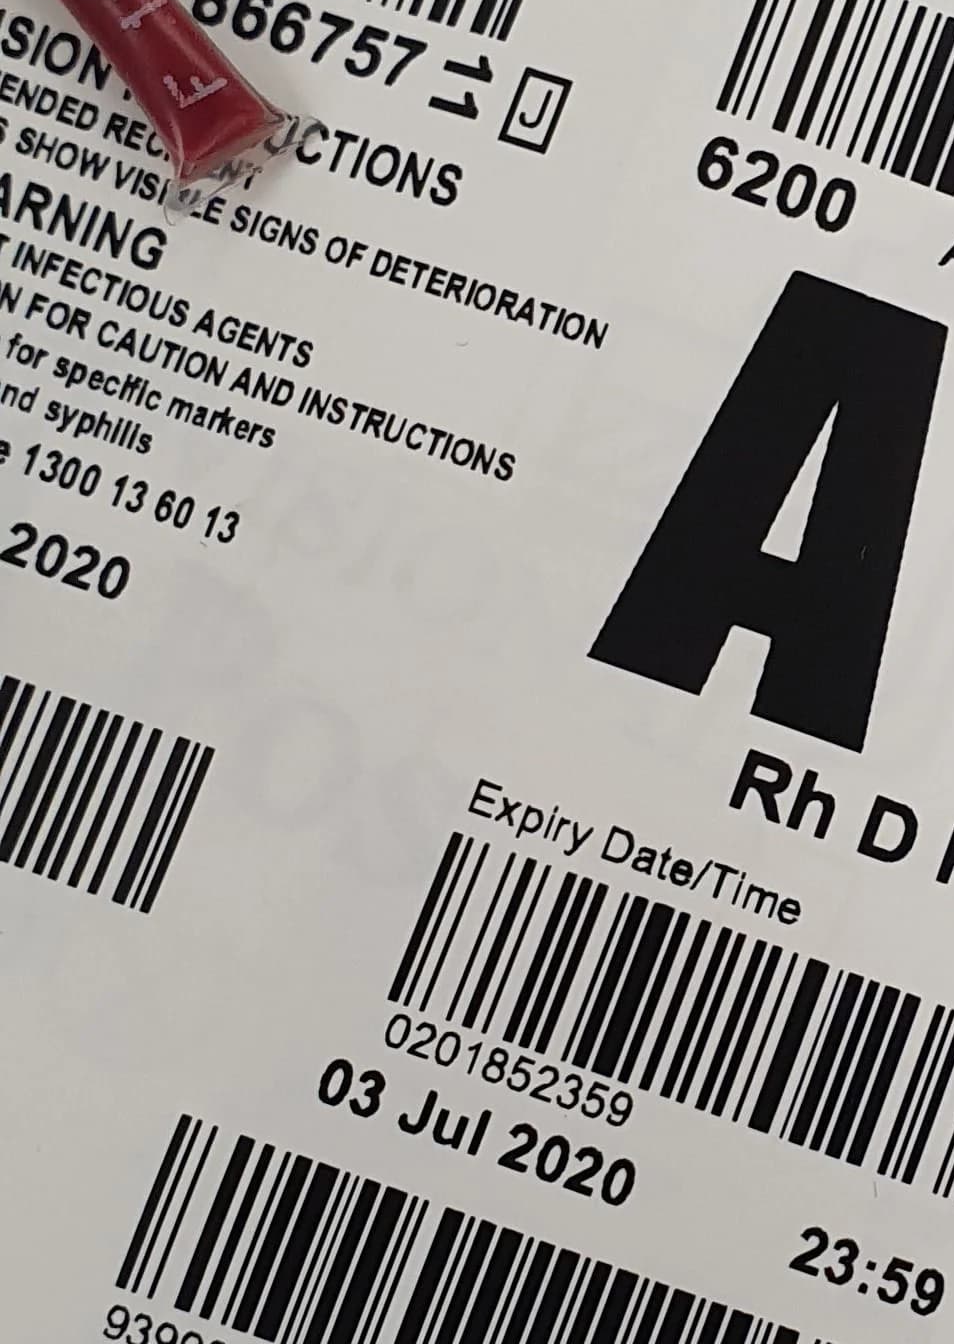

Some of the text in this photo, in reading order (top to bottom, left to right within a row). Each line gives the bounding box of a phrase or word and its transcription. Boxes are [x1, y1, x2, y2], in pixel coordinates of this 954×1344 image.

[0, 9, 112, 91] SION
[163, 75, 228, 108] F
[16, 127, 111, 181] SHOW
[230, 205, 319, 256] SIGNS
[326, 236, 368, 267] OF
[369, 251, 609, 350] DETERIORATION
[697, 136, 857, 233] 6200
[11, 241, 313, 368] INFECTIOUS AGENTS
[6, 332, 276, 449] for specific markers
[25, 291, 92, 339] FOR
[97, 320, 230, 387] CAUTION
[230, 367, 294, 407] AND
[298, 386, 515, 482] INSTRUCTIONS
[44, 399, 153, 456] syphilis
[24, 443, 102, 497] 1300
[112, 474, 148, 513] 13
[155, 490, 194, 531] 60
[203, 504, 240, 544] 13
[587, 269, 948, 753] A
[0, 522, 131, 600] 2020
[468, 778, 802, 926] Expiry Date/Time
[728, 749, 836, 839] Rh
[857, 794, 918, 863] D
[384, 1013, 634, 1127] 0201852359
[317, 1058, 636, 1206] 03 Jul 2020
[788, 1226, 945, 1316] 23:59
